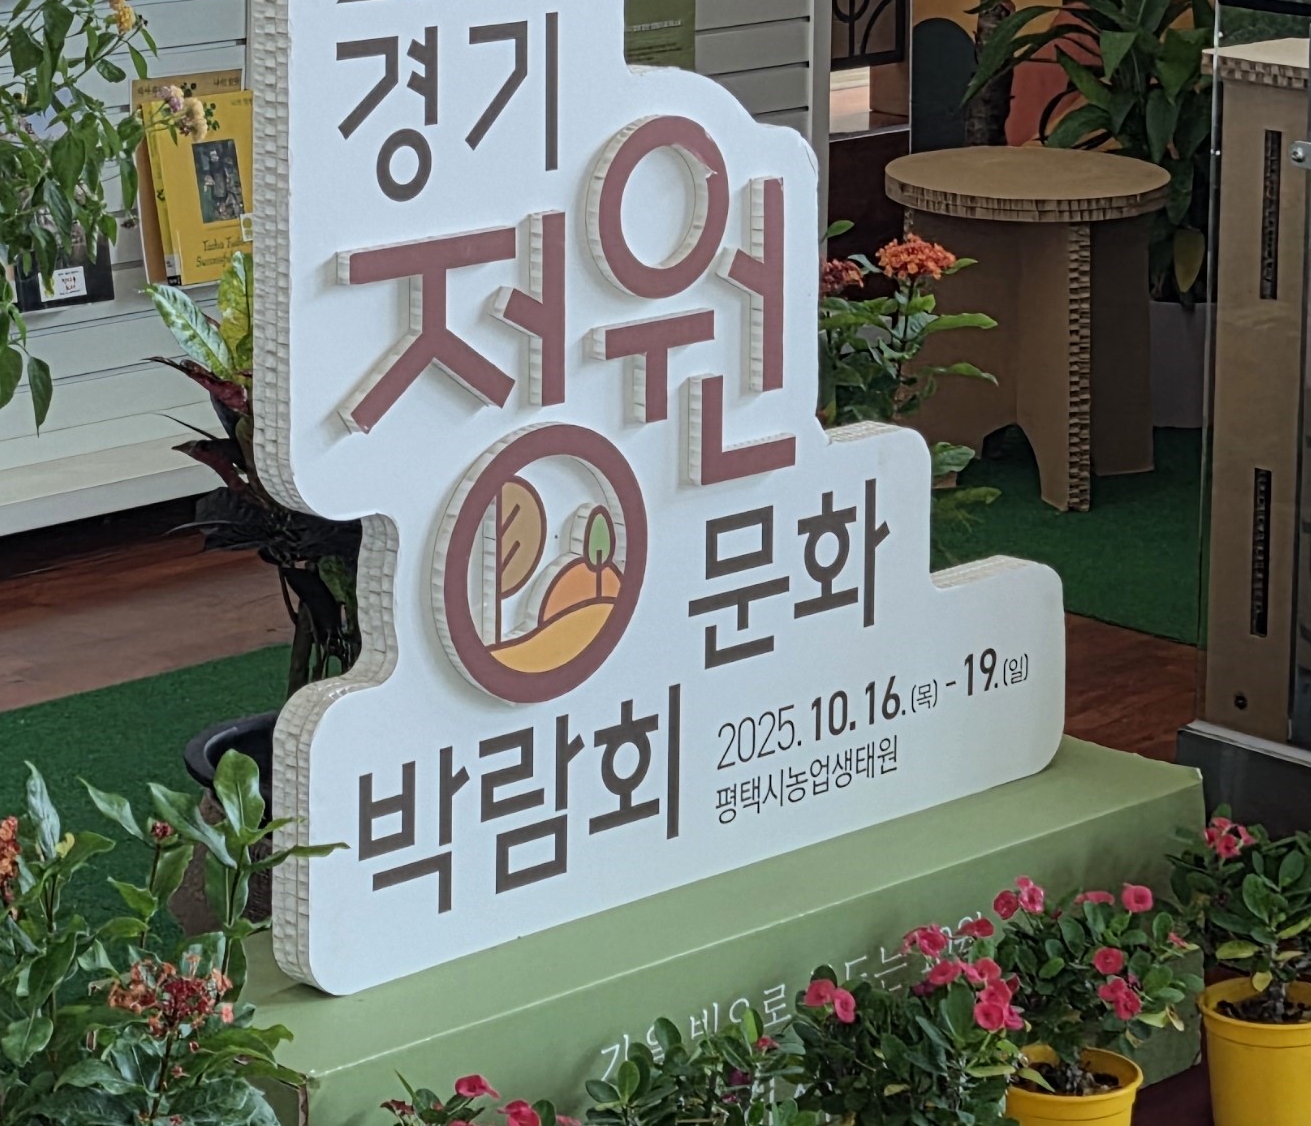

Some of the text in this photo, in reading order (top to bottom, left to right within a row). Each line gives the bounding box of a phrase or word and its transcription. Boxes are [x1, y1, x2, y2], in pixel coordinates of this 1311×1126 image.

[336, 12, 559, 202] 경기
[339, 115, 796, 704] 정원
[688, 478, 891, 670] 문화
[357, 682, 681, 915] 박람회
[715, 734, 898, 825] 평택시농업생태원
[716, 704, 803, 771] 2025.
